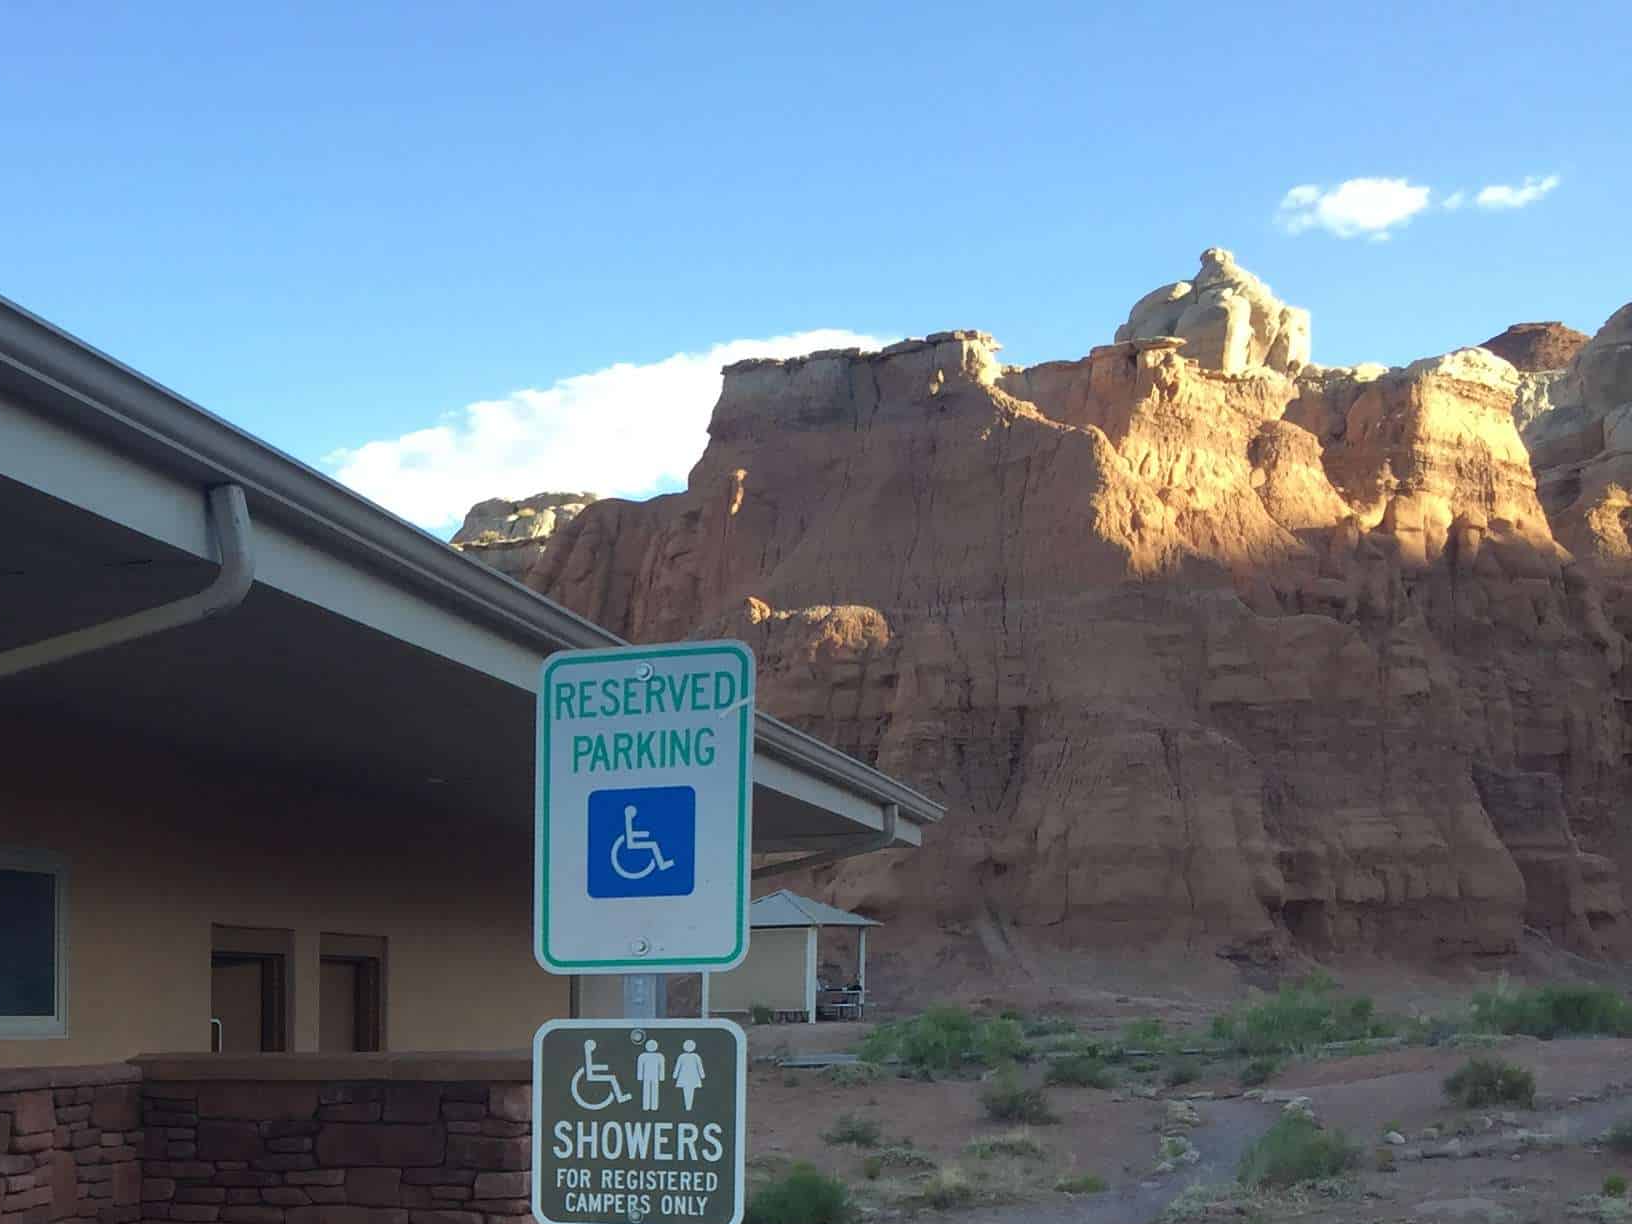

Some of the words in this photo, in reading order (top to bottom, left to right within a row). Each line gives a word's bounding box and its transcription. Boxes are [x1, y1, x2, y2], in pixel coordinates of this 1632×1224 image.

[555, 671, 736, 720] RESERVED
[572, 728, 715, 773] PARKING
[552, 1120, 724, 1162] SHOWERS
[556, 1168, 591, 1188] FOR
[600, 1168, 718, 1192] REGISTERED
[565, 1192, 651, 1214] CAMPERS
[661, 1195, 708, 1216] ONLY
